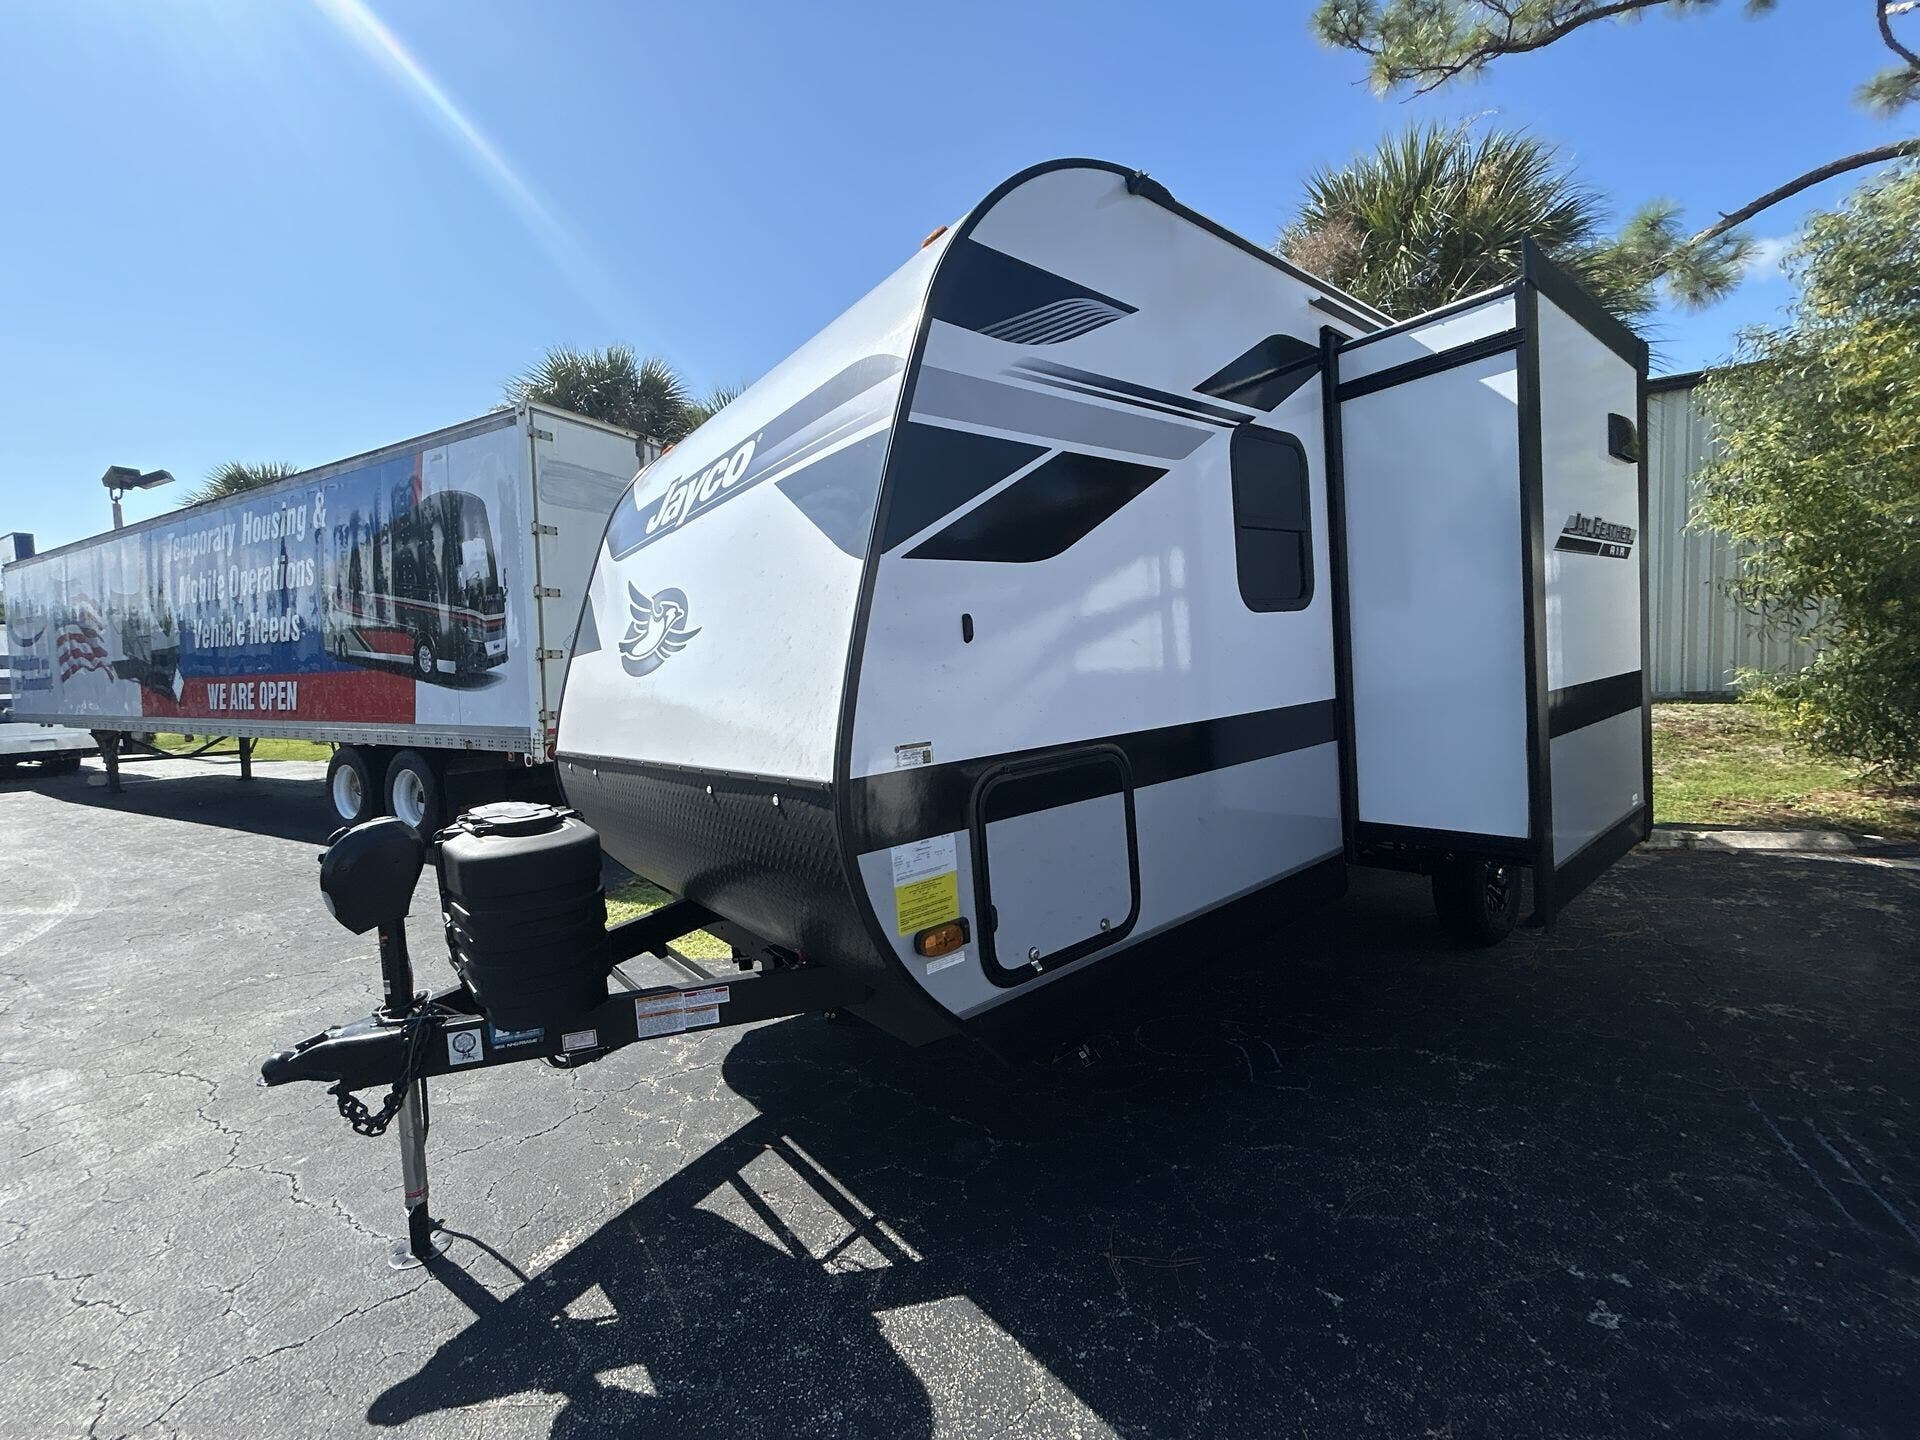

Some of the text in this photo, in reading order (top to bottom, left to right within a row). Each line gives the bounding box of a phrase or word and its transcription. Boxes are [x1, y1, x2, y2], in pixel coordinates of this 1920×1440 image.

[645, 440, 756, 534] Jayco
[167, 492, 327, 564] Temporary Housing &
[179, 558, 315, 606] Mobile Operations
[193, 607, 300, 649] Vehicle Needs
[207, 681, 298, 711] WE ARE OPEN
